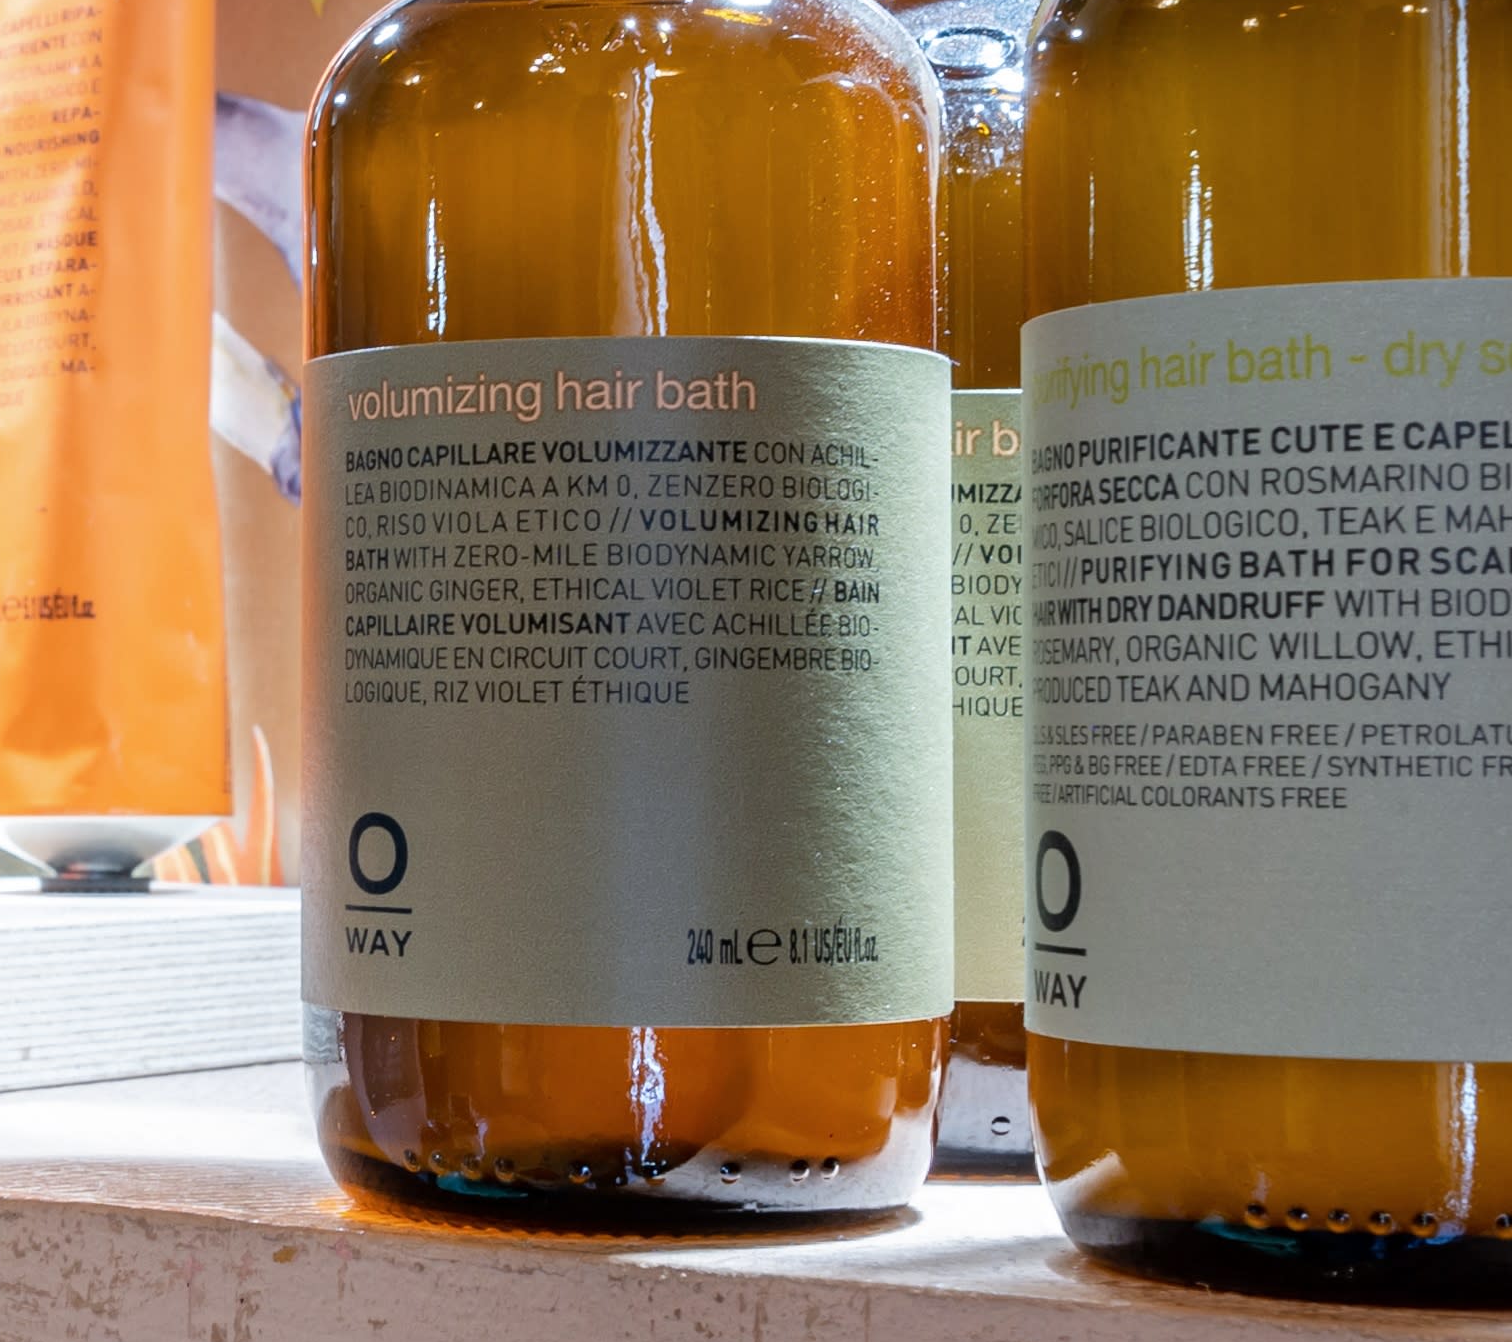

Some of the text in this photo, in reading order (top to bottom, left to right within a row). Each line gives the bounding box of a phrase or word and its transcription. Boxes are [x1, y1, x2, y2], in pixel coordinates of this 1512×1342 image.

[1139, 340, 1216, 390] hair
[1228, 332, 1332, 384] bath
[1382, 328, 1467, 387] dry
[347, 369, 758, 422] volumizing hair bath
[345, 440, 804, 473] BAGNO CAPILLARE VOLUMIZZANTE CON
[1078, 428, 1261, 464] PURIFICANTE
[1270, 425, 1364, 452] CUTE
[380, 474, 775, 503] BIODINAMICA KM ZENZERO
[1100, 475, 1179, 504] SECCA
[1185, 471, 1251, 500] CON
[1260, 466, 1469, 496] ROSMARINO
[376, 508, 879, 537] RISO VIOLA VOLUMIZING HAIR
[1064, 516, 1133, 546] SALICE
[1140, 509, 1308, 542] BIOLOGICO,
[1317, 507, 1406, 536] TEAK
[345, 543, 776, 571] BATH WITH ZERO-MILE BIODYNAMIC
[1081, 552, 1230, 585] PURIFYING
[1240, 548, 1334, 579] BATH
[1346, 548, 1419, 576] FOR
[345, 577, 804, 606] ORGANIC GINGER, ETHICAL VIOLET RICE
[345, 612, 705, 637] CAPILLAIRE VOLUMISANT AVEC
[1058, 596, 1102, 627] WITH
[1107, 594, 1154, 624] DRY
[1158, 591, 1324, 622] DANDRUFF
[1333, 590, 1419, 617] WITH
[489, 646, 689, 673] CIRCUIT COURT,
[1126, 634, 1254, 662] ORGANIC
[1269, 631, 1421, 663] WILLOW,
[433, 674, 690, 705] RIZ VIOLET ÉTHIQUE
[1116, 672, 1450, 704] TEAK AND MAHOGANY
[1153, 724, 1263, 746] PARABEN
[1327, 754, 1472, 776] SYNTHETIC
[1140, 785, 1347, 809] COLORANTS FREE
[349, 811, 408, 895] O
[1034, 829, 1081, 931] O
[345, 929, 412, 957] WAY
[687, 930, 714, 963] 240
[788, 927, 808, 963] 8.1
[1034, 973, 1087, 1007] WAY
